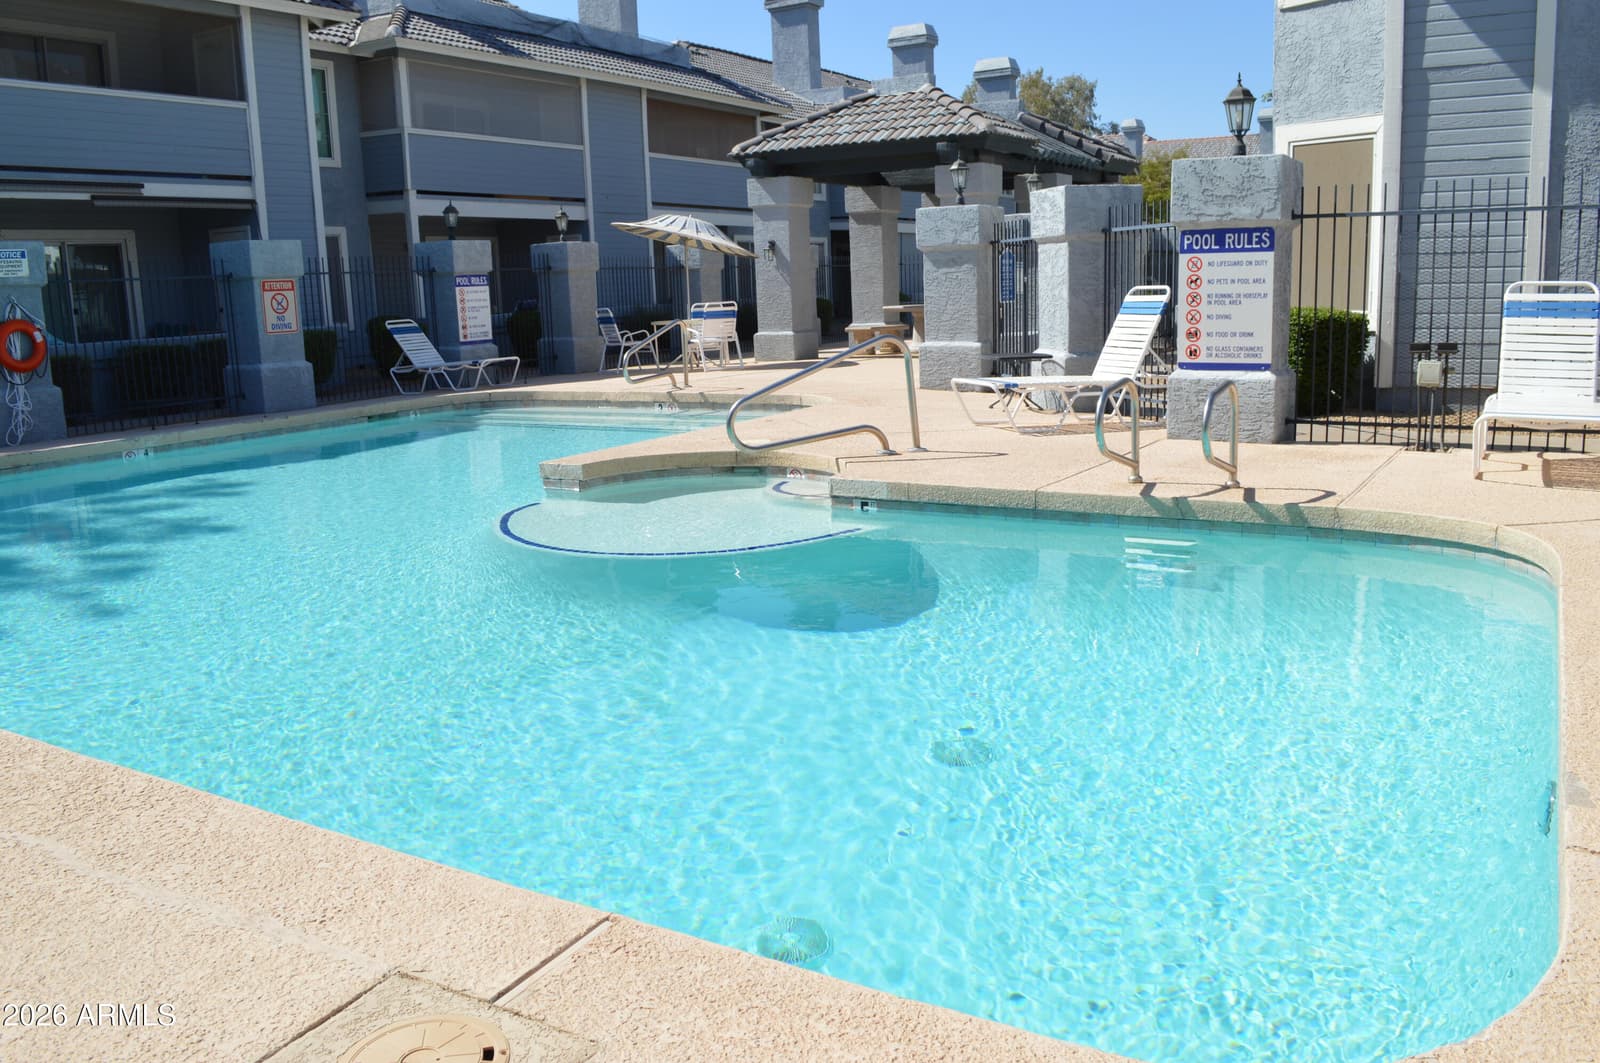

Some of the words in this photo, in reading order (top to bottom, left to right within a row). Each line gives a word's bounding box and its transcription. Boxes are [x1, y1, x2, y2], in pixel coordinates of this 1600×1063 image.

[1184, 233, 1219, 250] POOL
[1225, 231, 1271, 249] RULES
[456, 277, 470, 286] POOL
